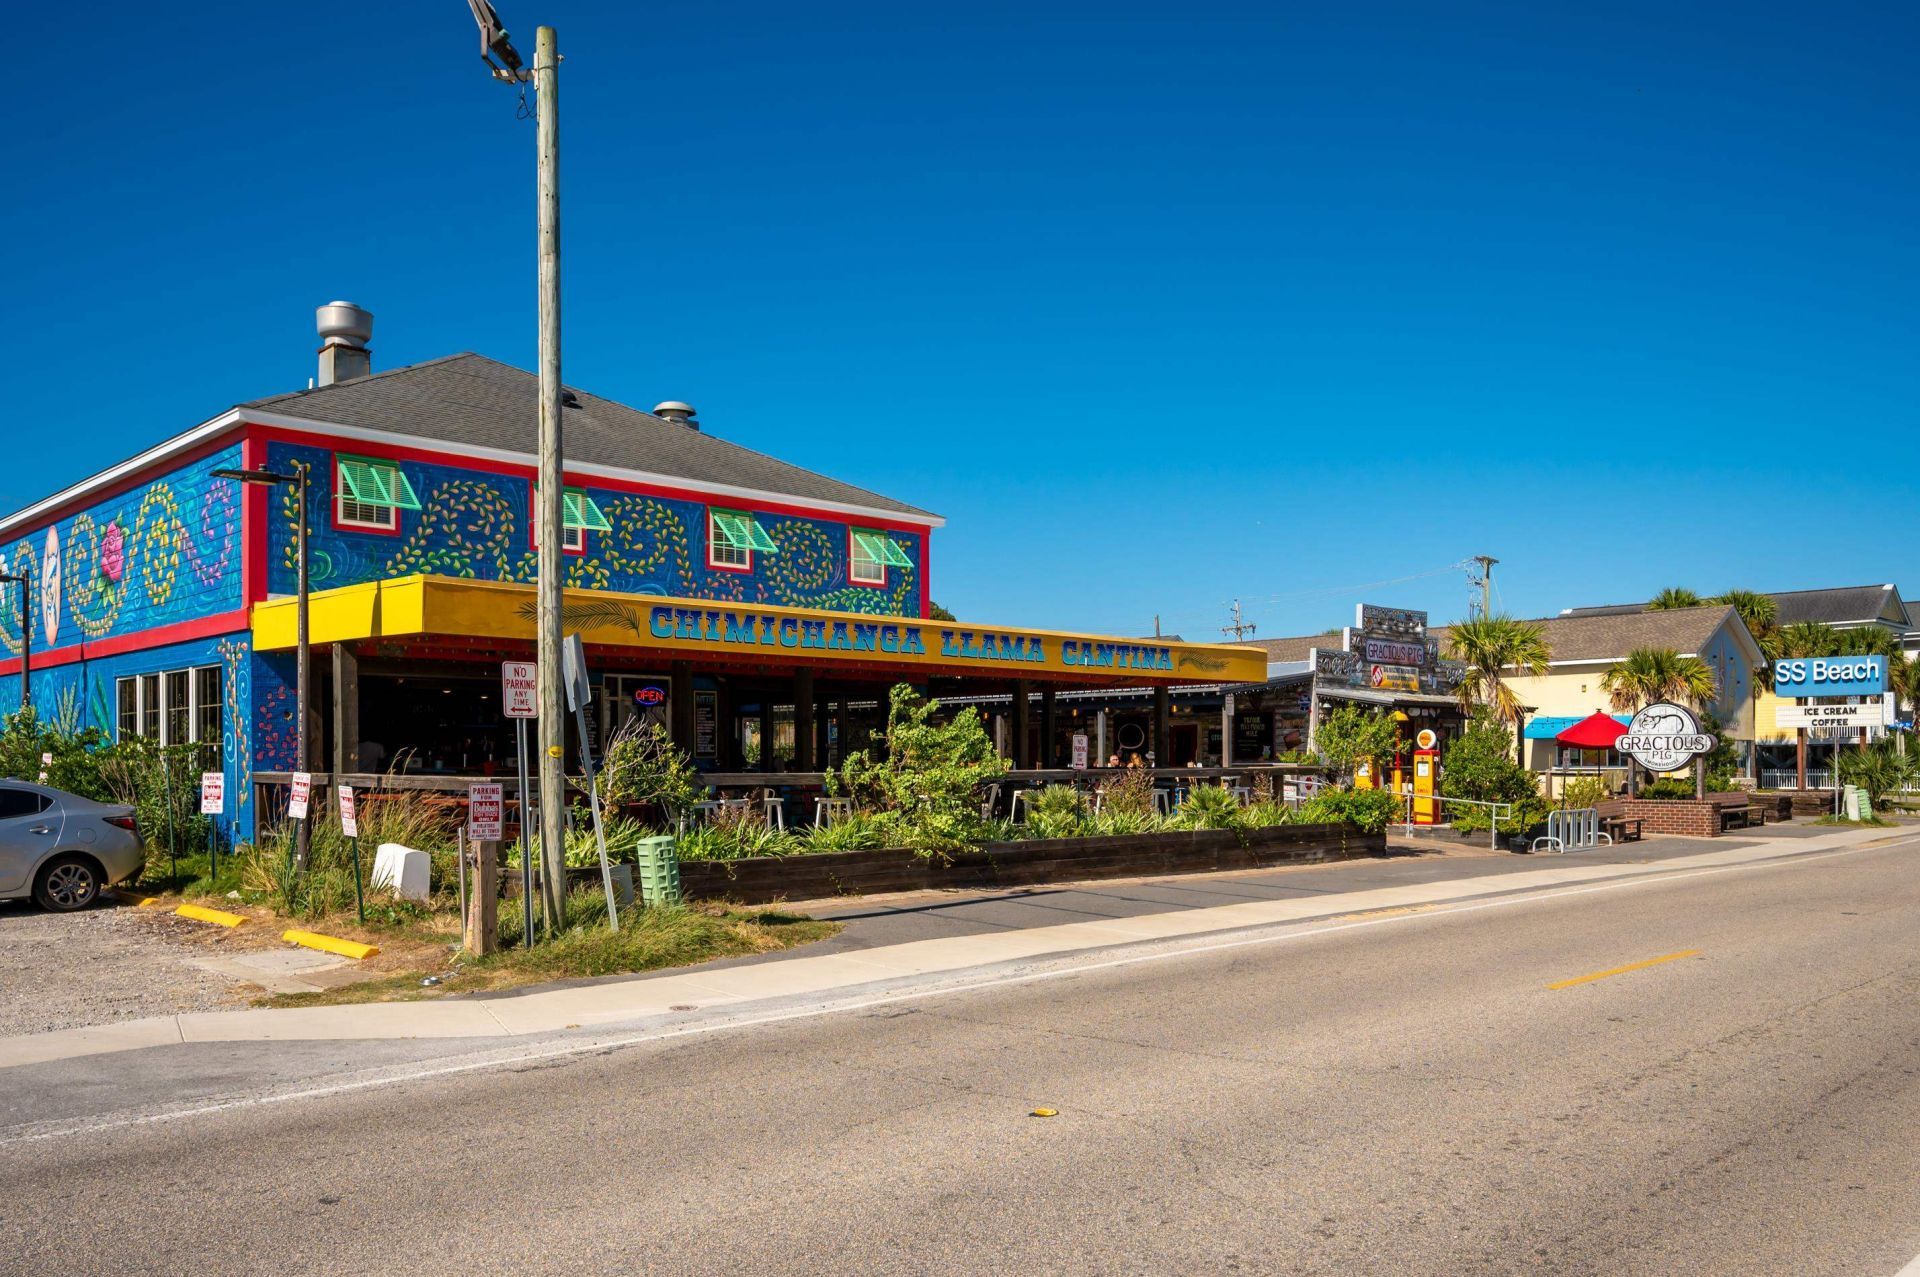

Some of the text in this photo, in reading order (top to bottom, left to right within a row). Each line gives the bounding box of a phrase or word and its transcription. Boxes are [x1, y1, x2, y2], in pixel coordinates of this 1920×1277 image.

[649, 606, 1174, 670] CHIMICHANGA LLAMA CANTINA
[1367, 643, 1423, 664] GRACIOUS PIG
[513, 667, 527, 678] NO
[1776, 658, 1879, 682] SS Beach
[505, 679, 536, 690] PARKING
[635, 689, 664, 702] OPEN
[1804, 706, 1858, 716] ICE CREAM
[1811, 718, 1849, 726] COFFEE
[1620, 736, 1705, 750] GRACIOUS
[1652, 750, 1672, 760] PIG
[472, 787, 500, 795] PARKING
